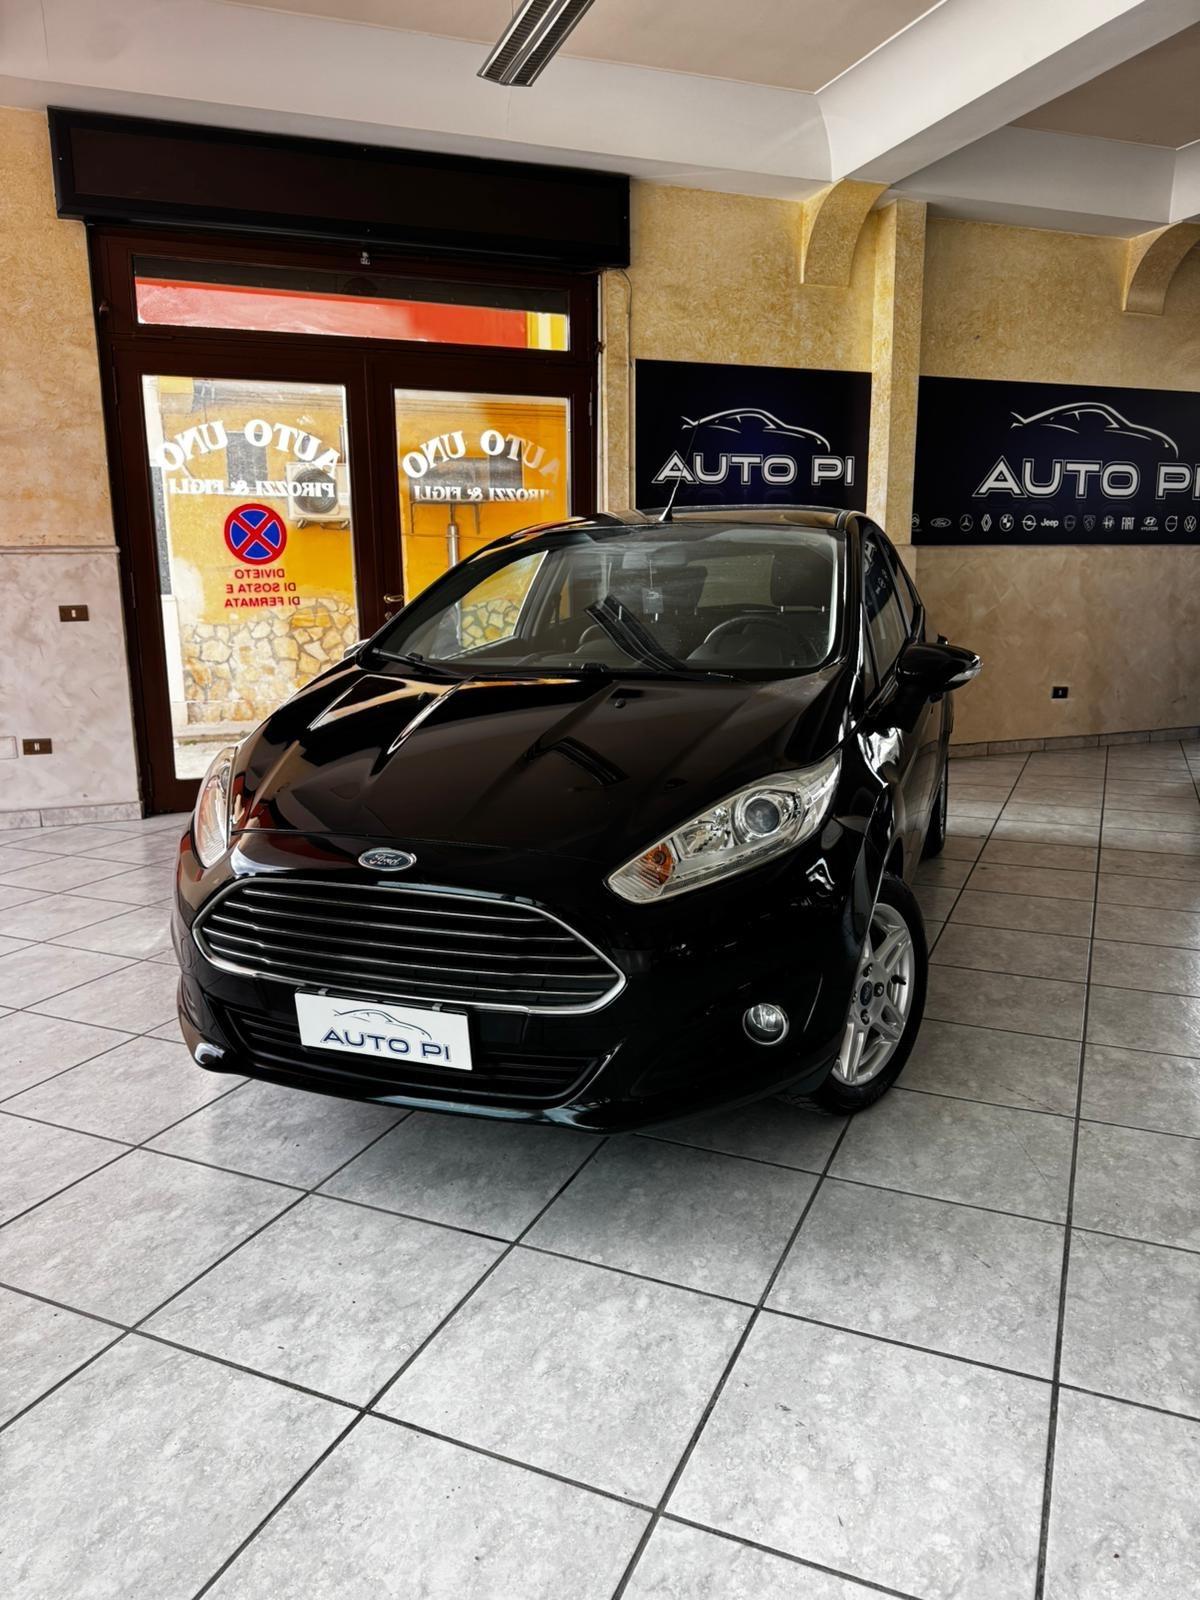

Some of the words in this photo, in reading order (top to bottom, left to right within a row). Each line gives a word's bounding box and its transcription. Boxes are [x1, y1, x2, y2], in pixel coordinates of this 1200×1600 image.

[651, 450, 797, 485] AUTO
[811, 456, 855, 486] PI
[972, 455, 1140, 500] AUTO
[1041, 518, 1059, 528] Jeep
[322, 1029, 409, 1053] AUTO
[421, 1041, 452, 1062] PI
